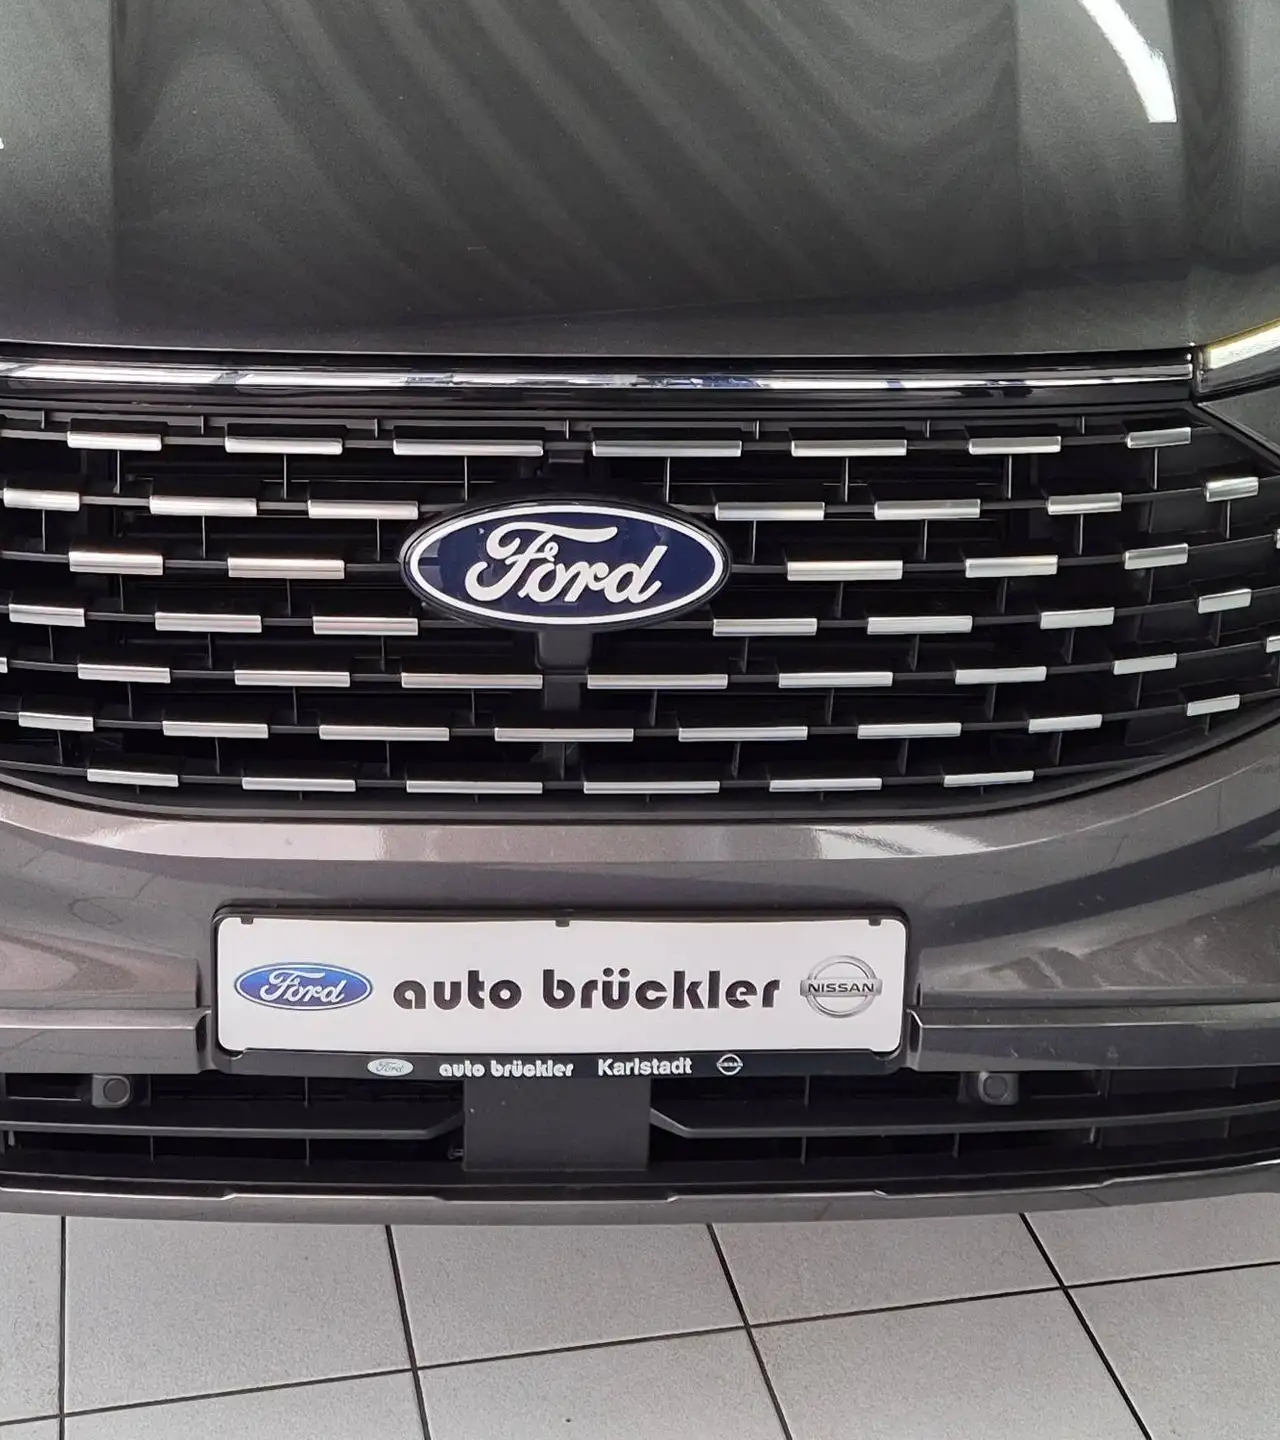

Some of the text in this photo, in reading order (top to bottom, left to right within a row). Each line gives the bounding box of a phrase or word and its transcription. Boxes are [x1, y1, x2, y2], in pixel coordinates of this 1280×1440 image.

[464, 521, 668, 604] Ford
[259, 966, 875, 1010] Ford auto brückler NISSAN
[438, 1060, 486, 1077] auto
[490, 1059, 574, 1078] brückler
[597, 1057, 693, 1076] Karlstadt
